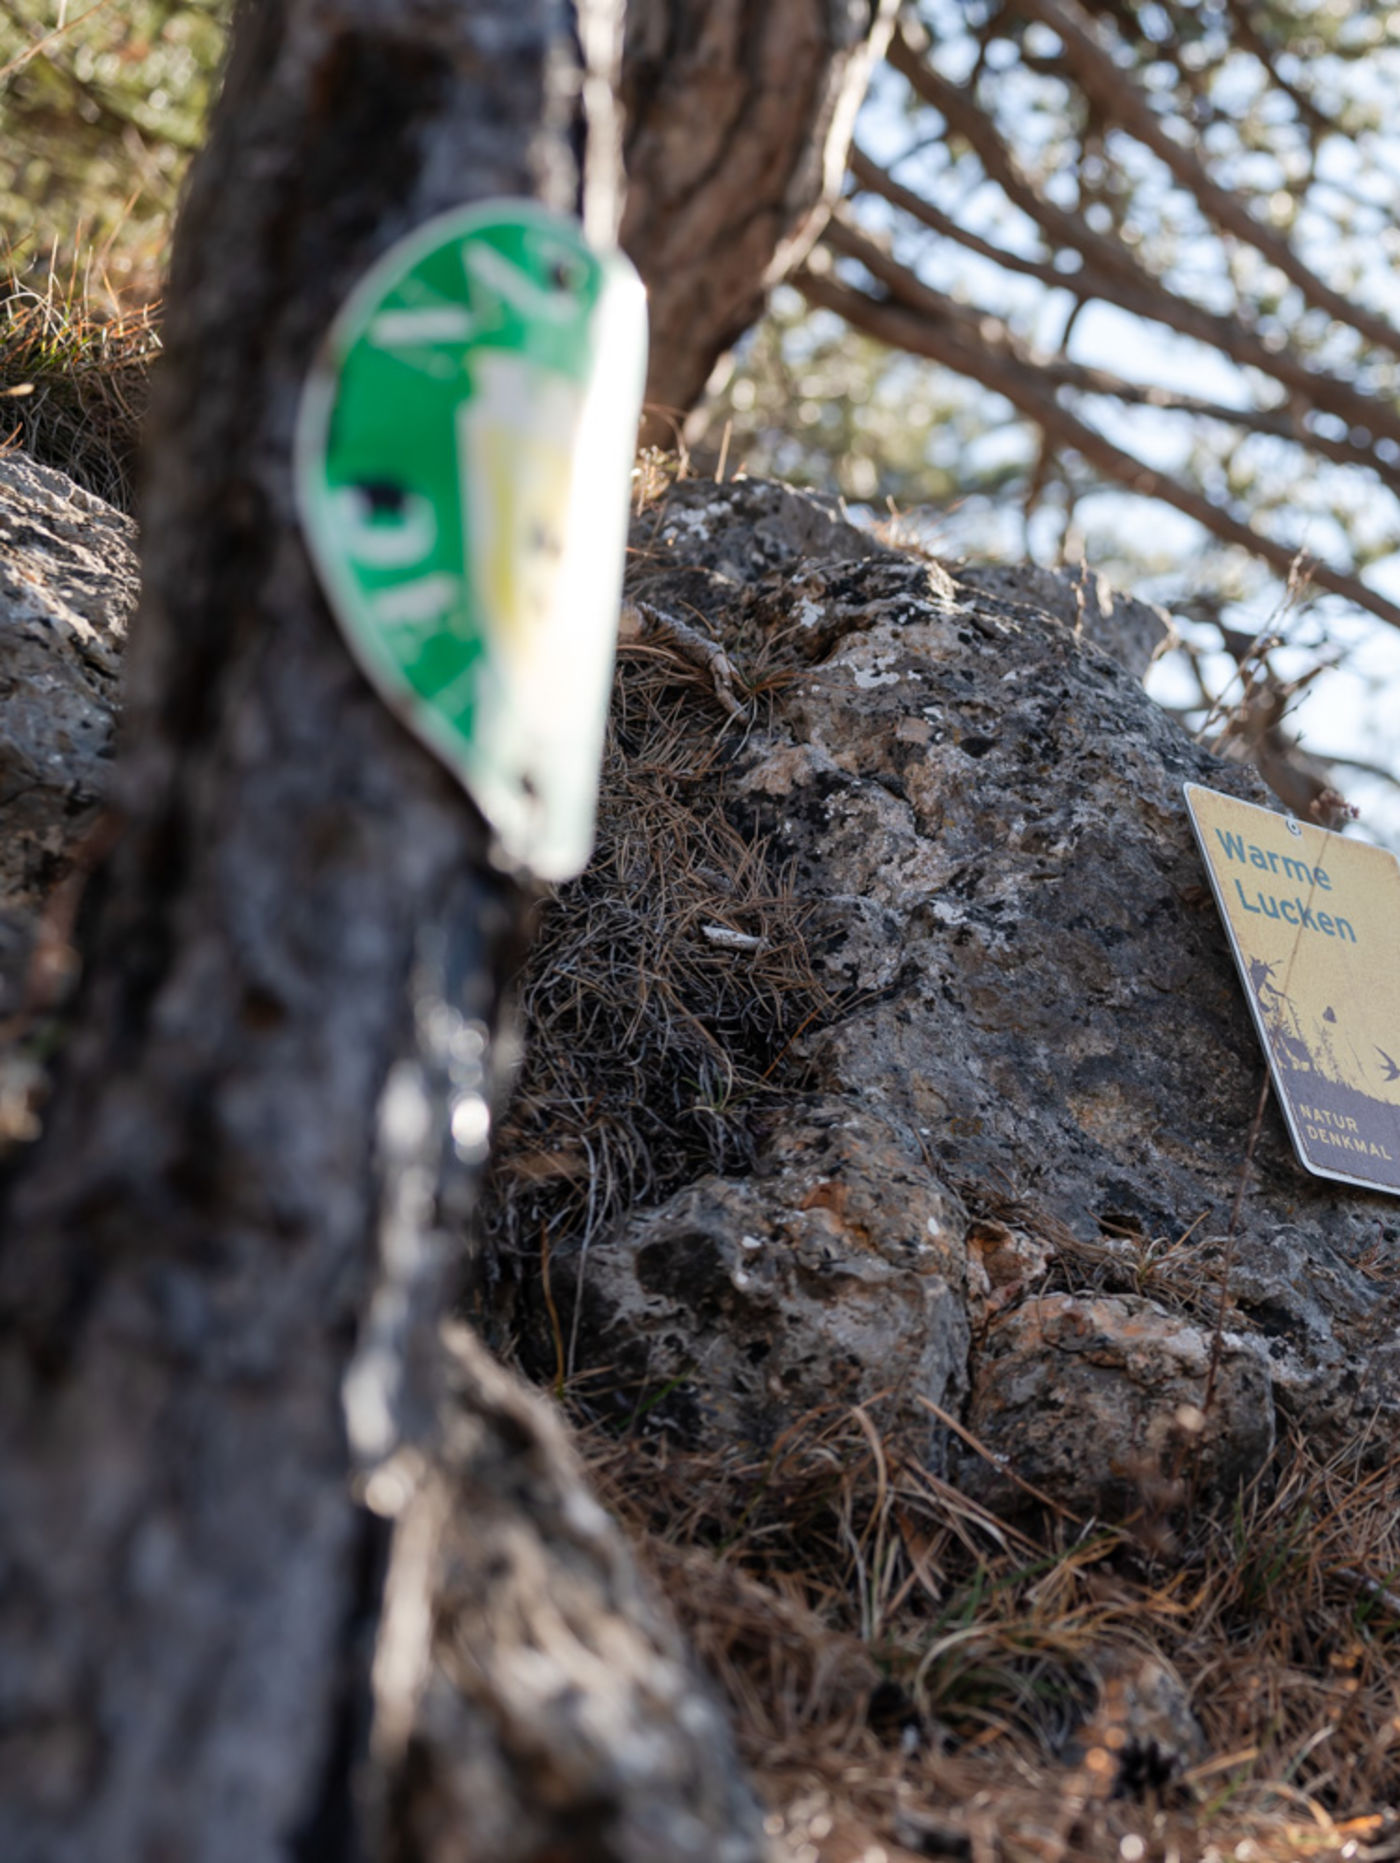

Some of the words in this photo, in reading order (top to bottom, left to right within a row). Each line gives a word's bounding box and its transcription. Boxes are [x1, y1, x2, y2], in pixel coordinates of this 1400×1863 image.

[1215, 828, 1332, 891] Warme
[1234, 879, 1357, 943] Lucken
[1300, 1104, 1358, 1133] NATUR
[1306, 1125, 1392, 1160] DENKMAL
